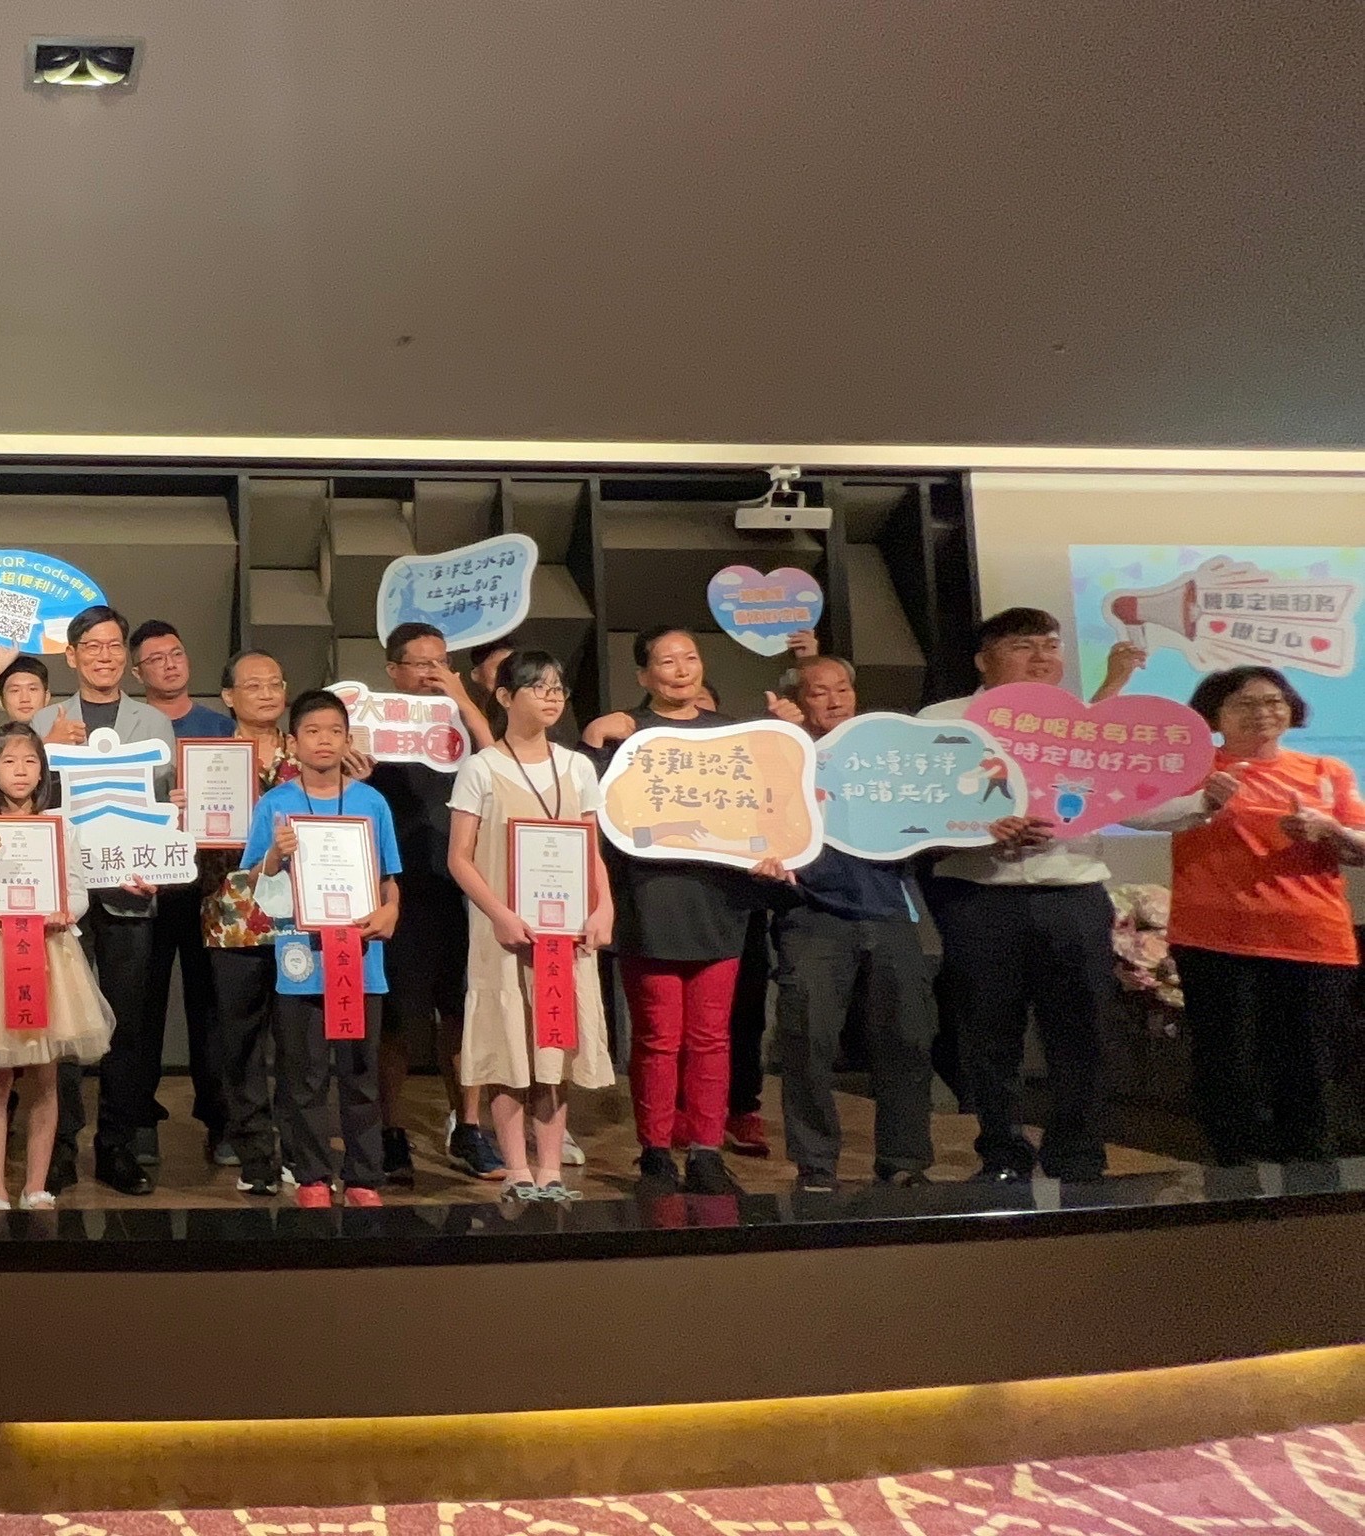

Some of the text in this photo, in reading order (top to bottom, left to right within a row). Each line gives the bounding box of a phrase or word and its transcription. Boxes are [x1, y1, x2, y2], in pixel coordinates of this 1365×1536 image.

[626, 745, 755, 782] 海灘認養
[839, 780, 952, 805] 和諧共存
[125, 871, 190, 884] Gvernment
